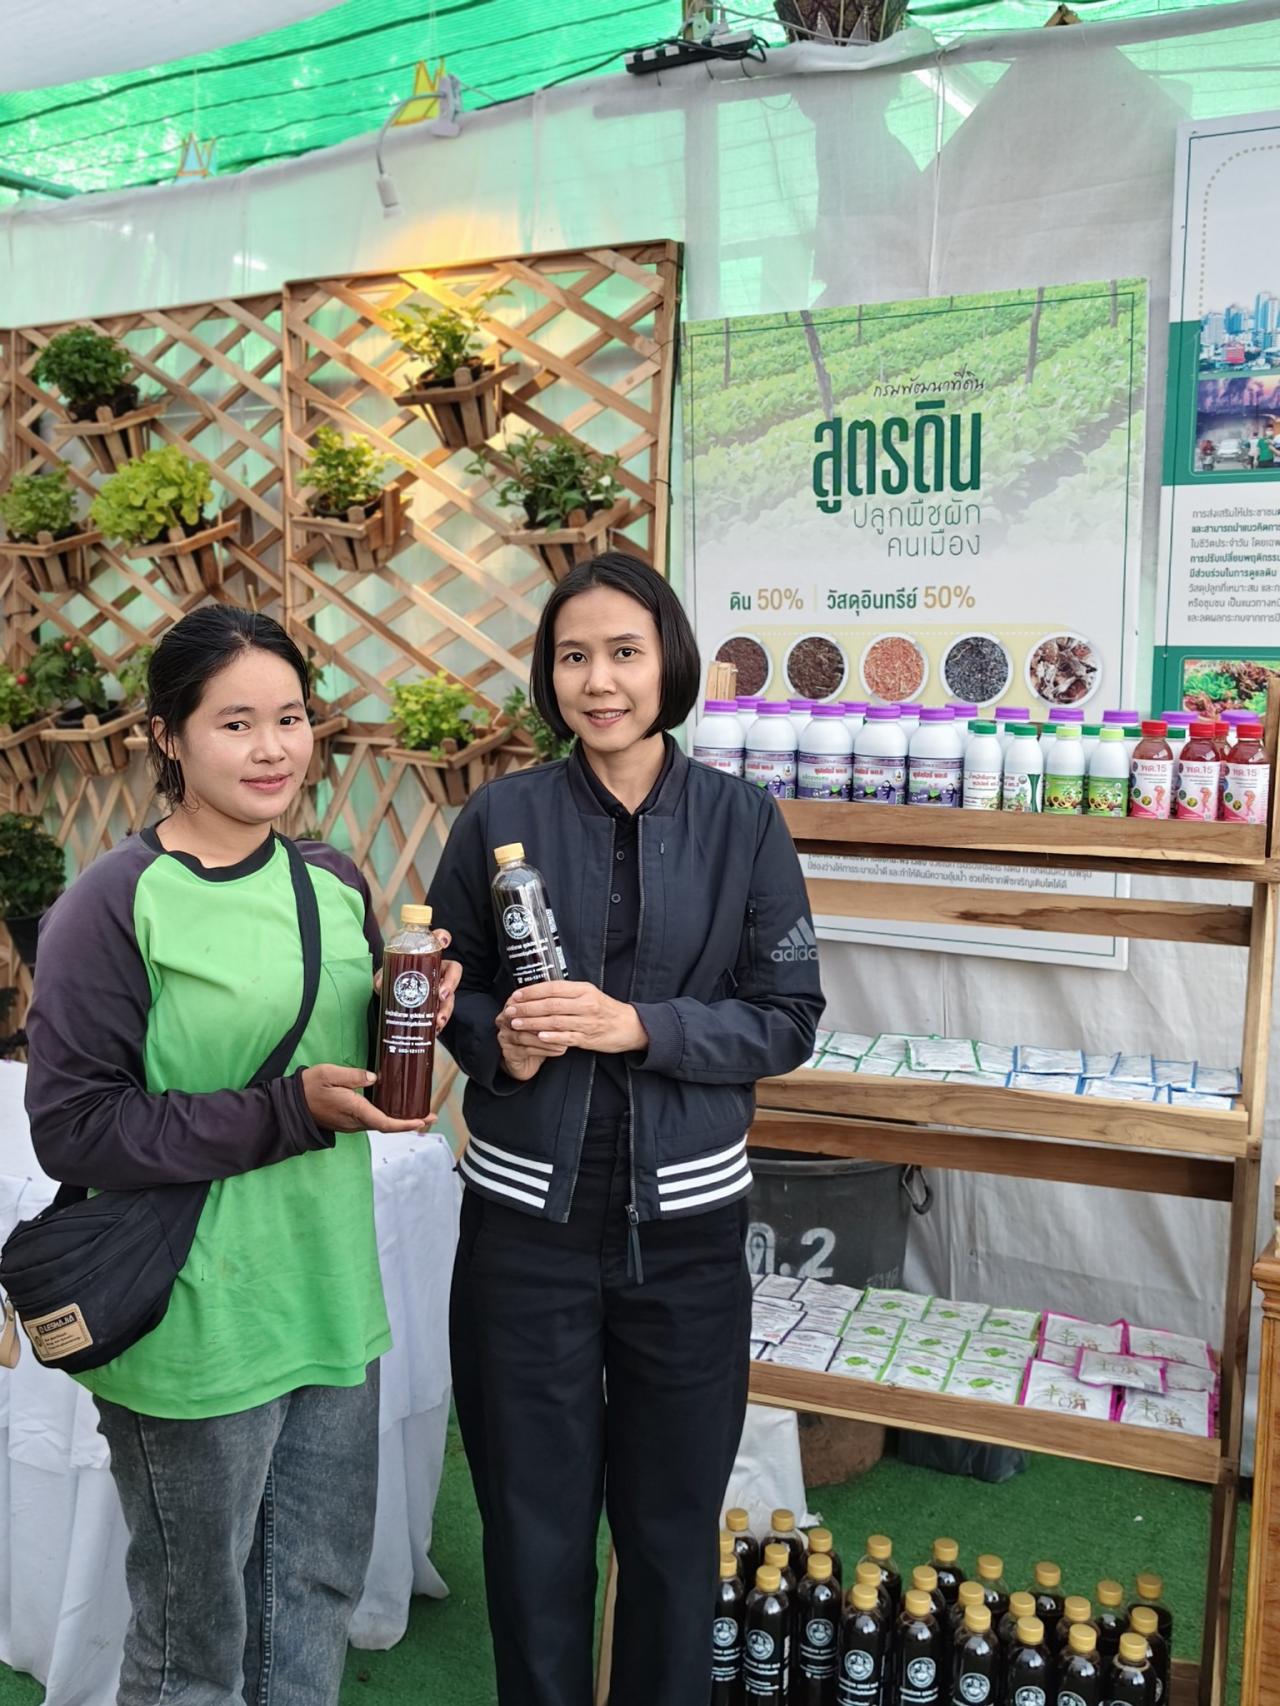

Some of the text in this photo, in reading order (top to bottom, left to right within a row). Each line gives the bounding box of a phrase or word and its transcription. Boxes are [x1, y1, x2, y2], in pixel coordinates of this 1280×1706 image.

[873, 363, 985, 397] กรมพัฒนาที่ดิน
[812, 400, 982, 514] สูตรดิน
[853, 498, 981, 535] ปลูกพืชผัก
[888, 529, 980, 557] คนเมือง
[730, 585, 976, 616] ดิน 50% วัสดุอินทรีย์ 50%
[770, 945, 817, 962] adida
